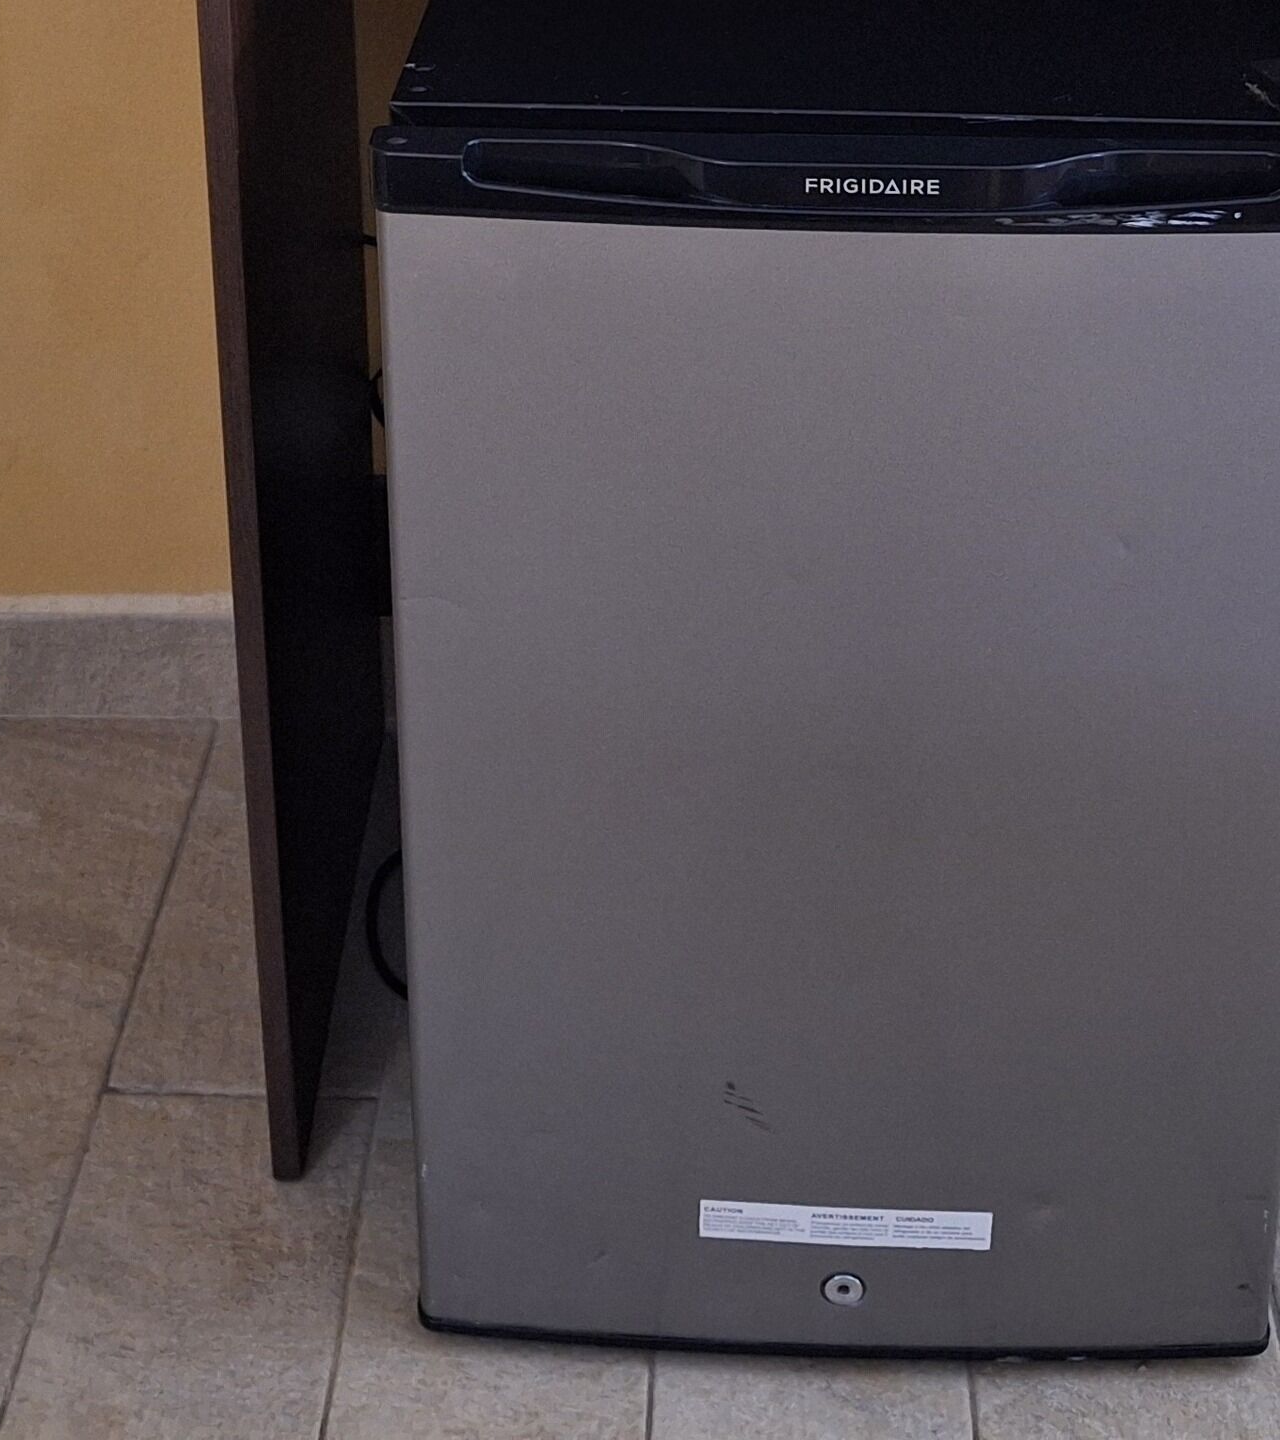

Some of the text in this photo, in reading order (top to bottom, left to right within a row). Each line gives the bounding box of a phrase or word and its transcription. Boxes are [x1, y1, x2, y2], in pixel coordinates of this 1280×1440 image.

[805, 178, 940, 196] FRIGIDAIRE
[703, 1206, 744, 1215] CAUTION
[811, 1213, 885, 1222] AVERTISSEMENT
[895, 1216, 935, 1224] CUIDADO
